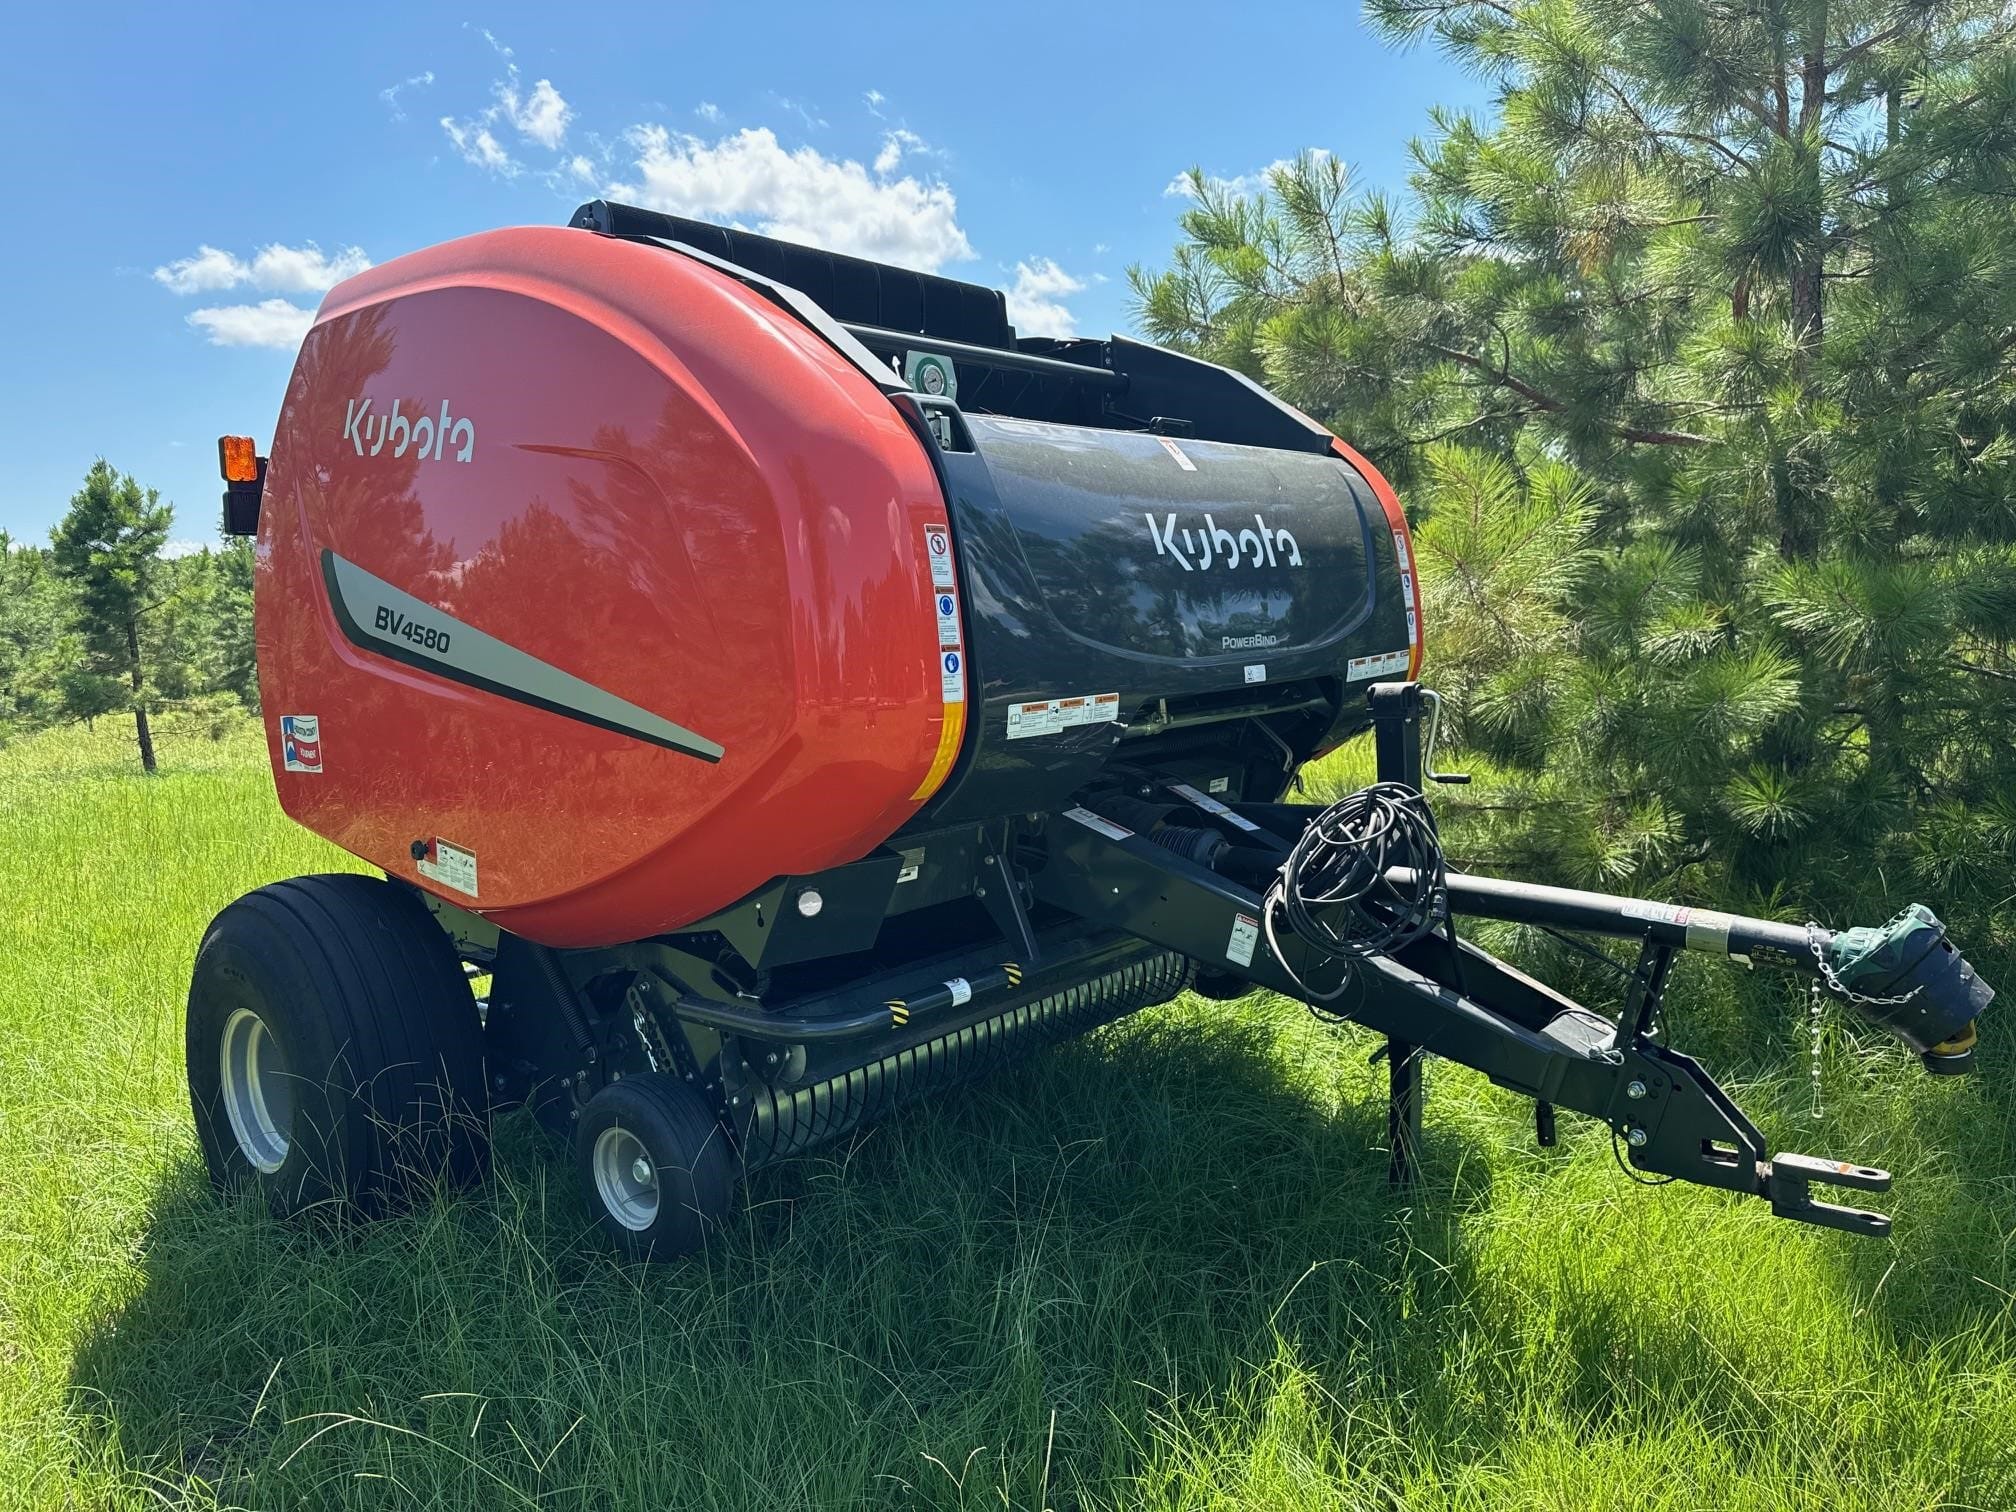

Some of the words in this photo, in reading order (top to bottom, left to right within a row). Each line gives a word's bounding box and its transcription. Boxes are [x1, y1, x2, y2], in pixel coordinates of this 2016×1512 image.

[343, 398, 475, 463] Kubota
[1144, 513, 1303, 571] Kubota
[374, 605, 451, 654] BV4580
